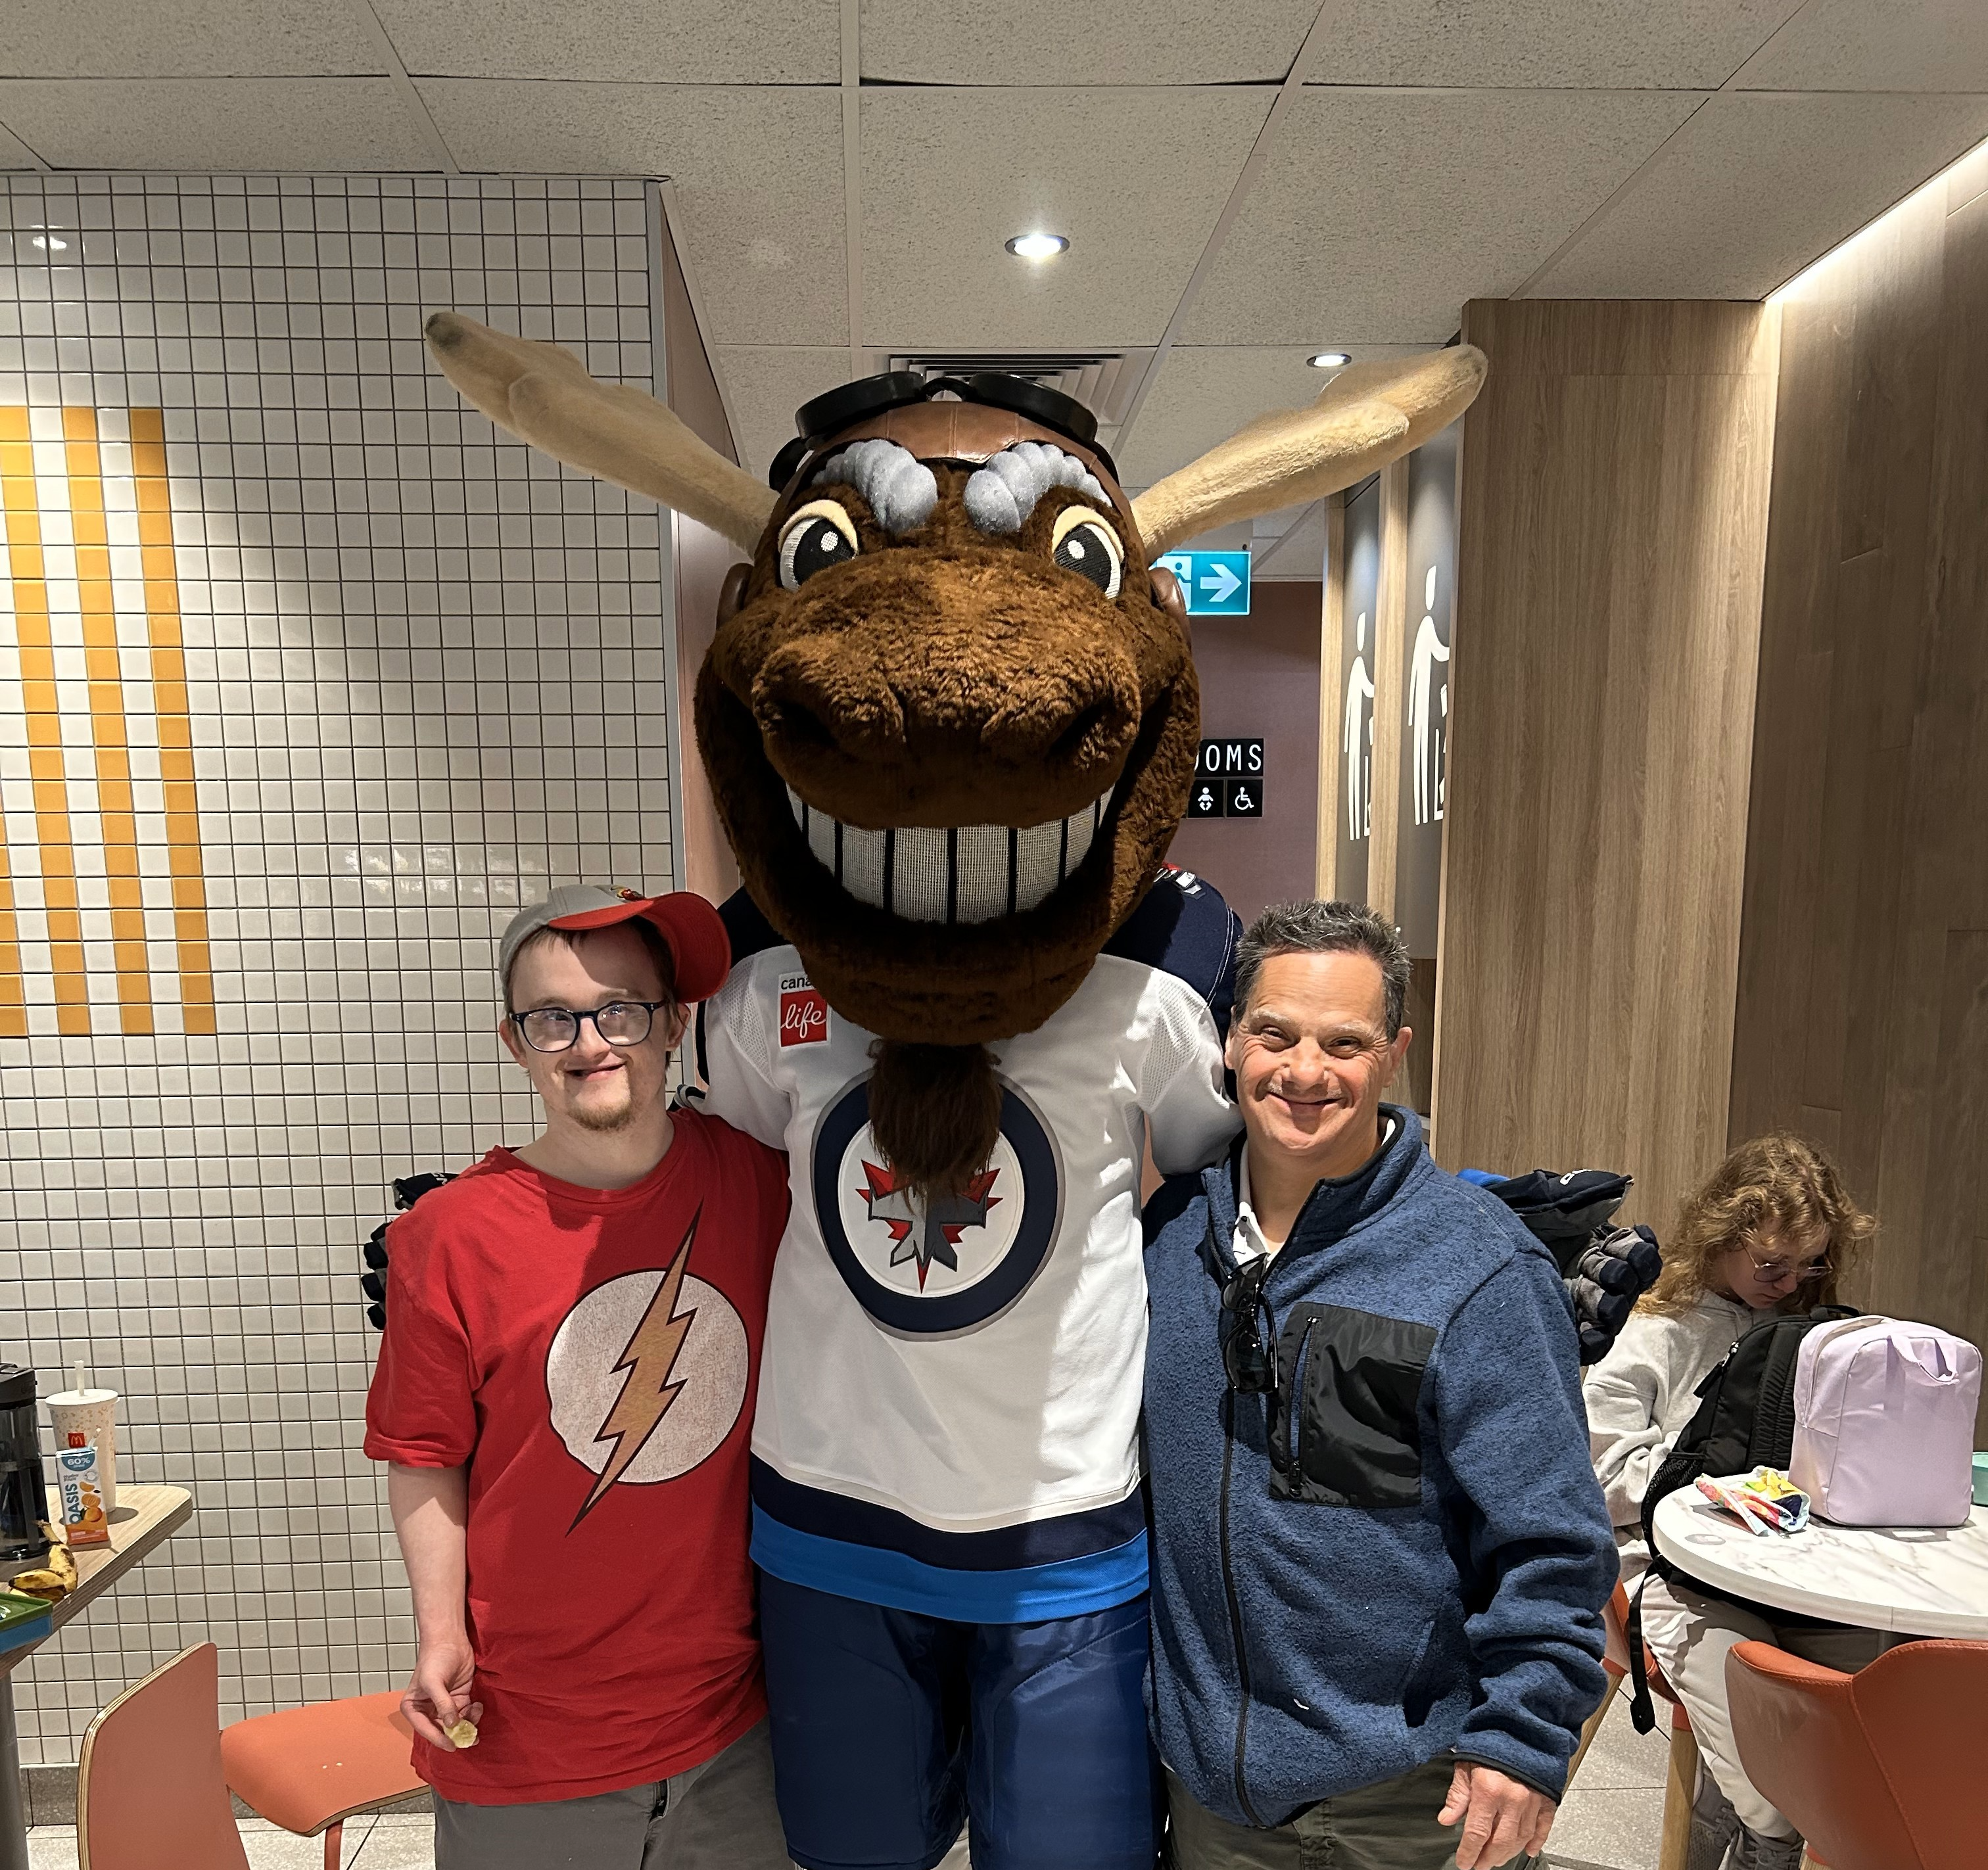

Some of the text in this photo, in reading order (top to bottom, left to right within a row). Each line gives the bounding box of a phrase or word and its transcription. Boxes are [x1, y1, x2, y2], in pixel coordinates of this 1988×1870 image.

[1194, 744, 1262, 771] OMS
[781, 1001, 826, 1039] life
[65, 1483, 82, 1524] OASIS
